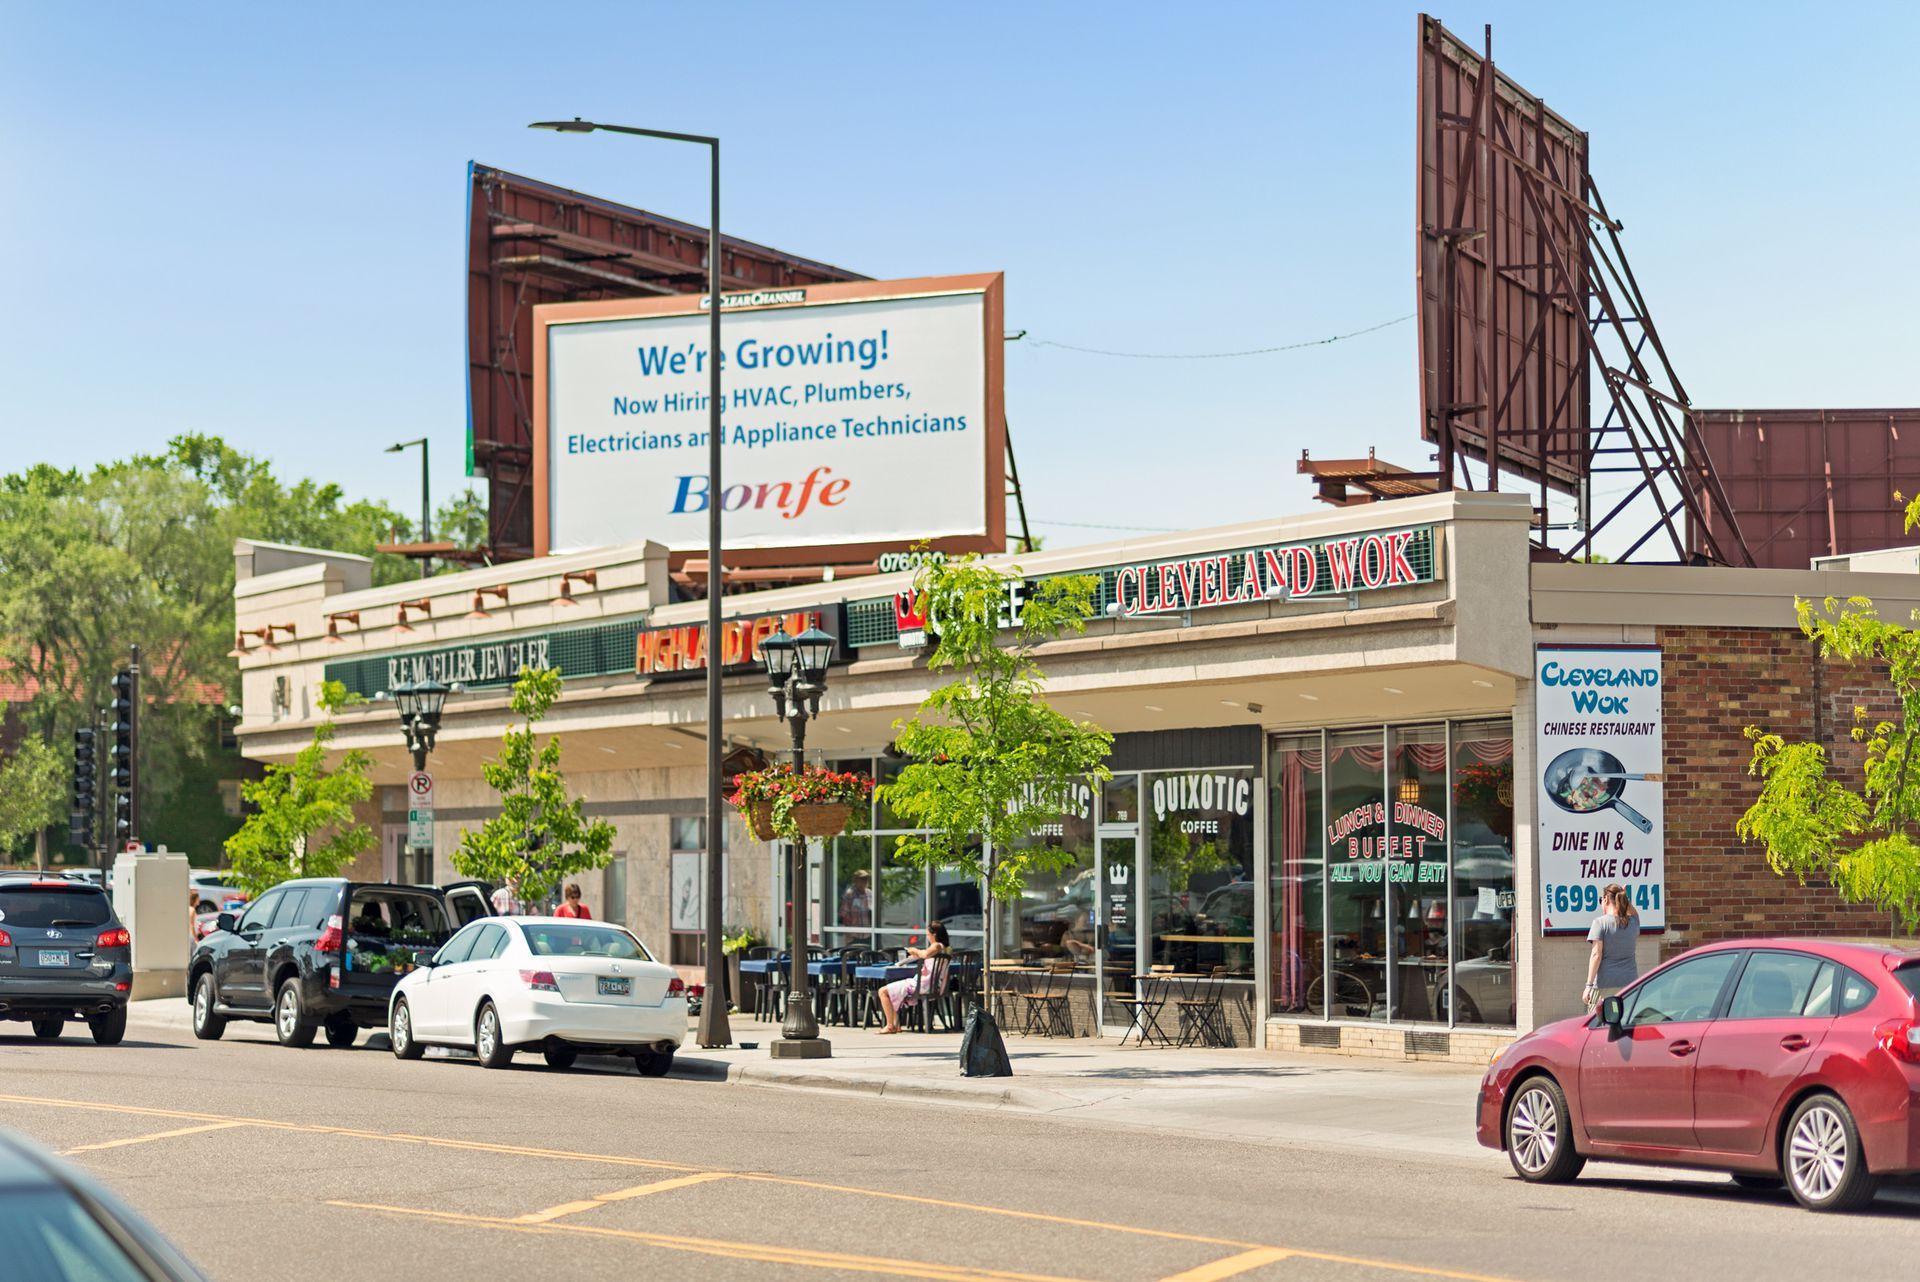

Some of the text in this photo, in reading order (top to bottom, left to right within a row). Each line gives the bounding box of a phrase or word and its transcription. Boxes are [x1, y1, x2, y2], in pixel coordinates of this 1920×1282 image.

[736, 329, 888, 370] Growing!
[613, 396, 658, 415] Now
[733, 385, 798, 408] HVAC,
[804, 380, 911, 404] Plumbers,
[568, 430, 682, 454] Electricians
[733, 421, 837, 449] Appliance
[841, 412, 967, 438] Technicians
[667, 466, 851, 519] Bonfe
[1115, 531, 1418, 617] CLEVELAND WOK
[480, 639, 550, 680] JEWELER
[1541, 661, 1659, 688] CLEVELAND
[1571, 690, 1629, 715] WOK
[1544, 722, 1656, 736] CHINESE RESTAURANT
[1153, 773, 1249, 822] QUIXOTIC
[1180, 820, 1219, 834] COFFEE
[1327, 801, 1446, 846] LUNCH & DINNER
[1348, 835, 1427, 859] BUFFET
[1552, 831, 1625, 851] DINE IN &
[1330, 862, 1447, 883] ALL YOU CAN EAT!
[1580, 857, 1654, 879] TAKE OUT
